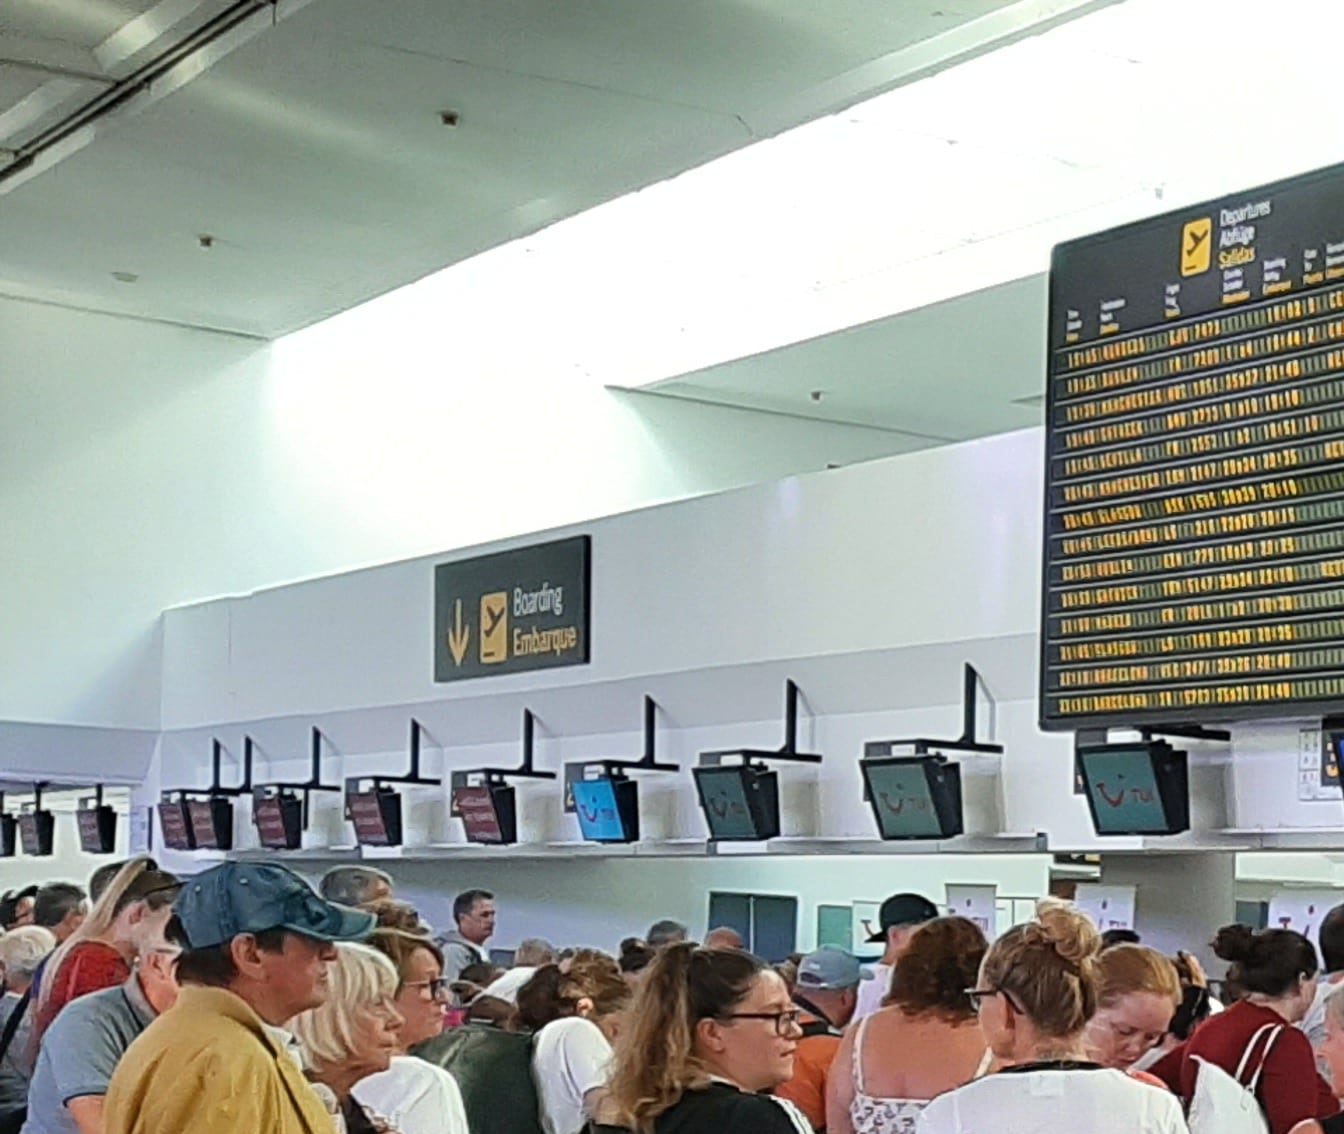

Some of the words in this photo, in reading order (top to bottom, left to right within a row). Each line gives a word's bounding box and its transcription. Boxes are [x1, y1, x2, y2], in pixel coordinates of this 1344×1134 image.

[1220, 201, 1271, 228] Departures
[1218, 246, 1256, 270] Salidas
[513, 581, 563, 616] Boarding
[513, 625, 577, 656] Embarque
